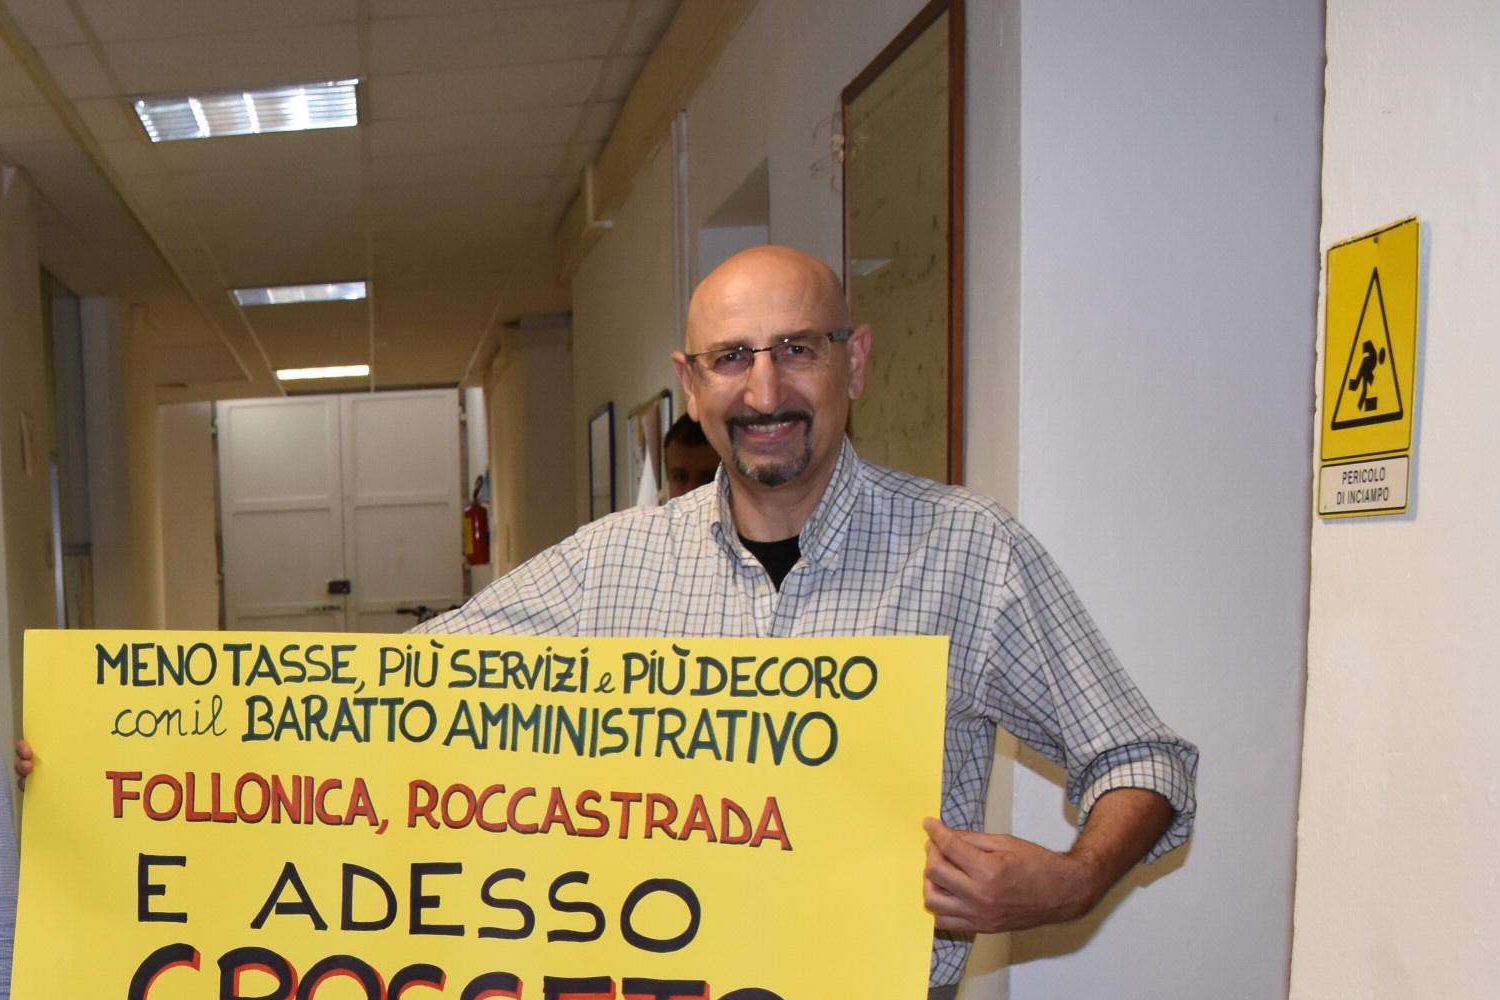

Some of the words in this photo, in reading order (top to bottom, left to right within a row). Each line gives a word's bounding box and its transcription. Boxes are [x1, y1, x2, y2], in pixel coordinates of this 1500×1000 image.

[1336, 491, 1346, 505] DI
[1347, 486, 1389, 505] INCIAMPO
[1341, 466, 1386, 485] PERICOLO
[96, 643, 218, 686] MENO
[223, 643, 366, 693] TASSE,
[593, 672, 616, 693] e
[690, 656, 878, 700] DECORO
[111, 708, 187, 738] con
[241, 694, 437, 742] BARATTO
[442, 699, 838, 767] AMMINISTRATIVO
[105, 770, 390, 835] FOLLONICA,
[407, 780, 793, 852] ROCCASTRADA
[137, 853, 188, 923] E
[250, 861, 701, 953] ADESSO
